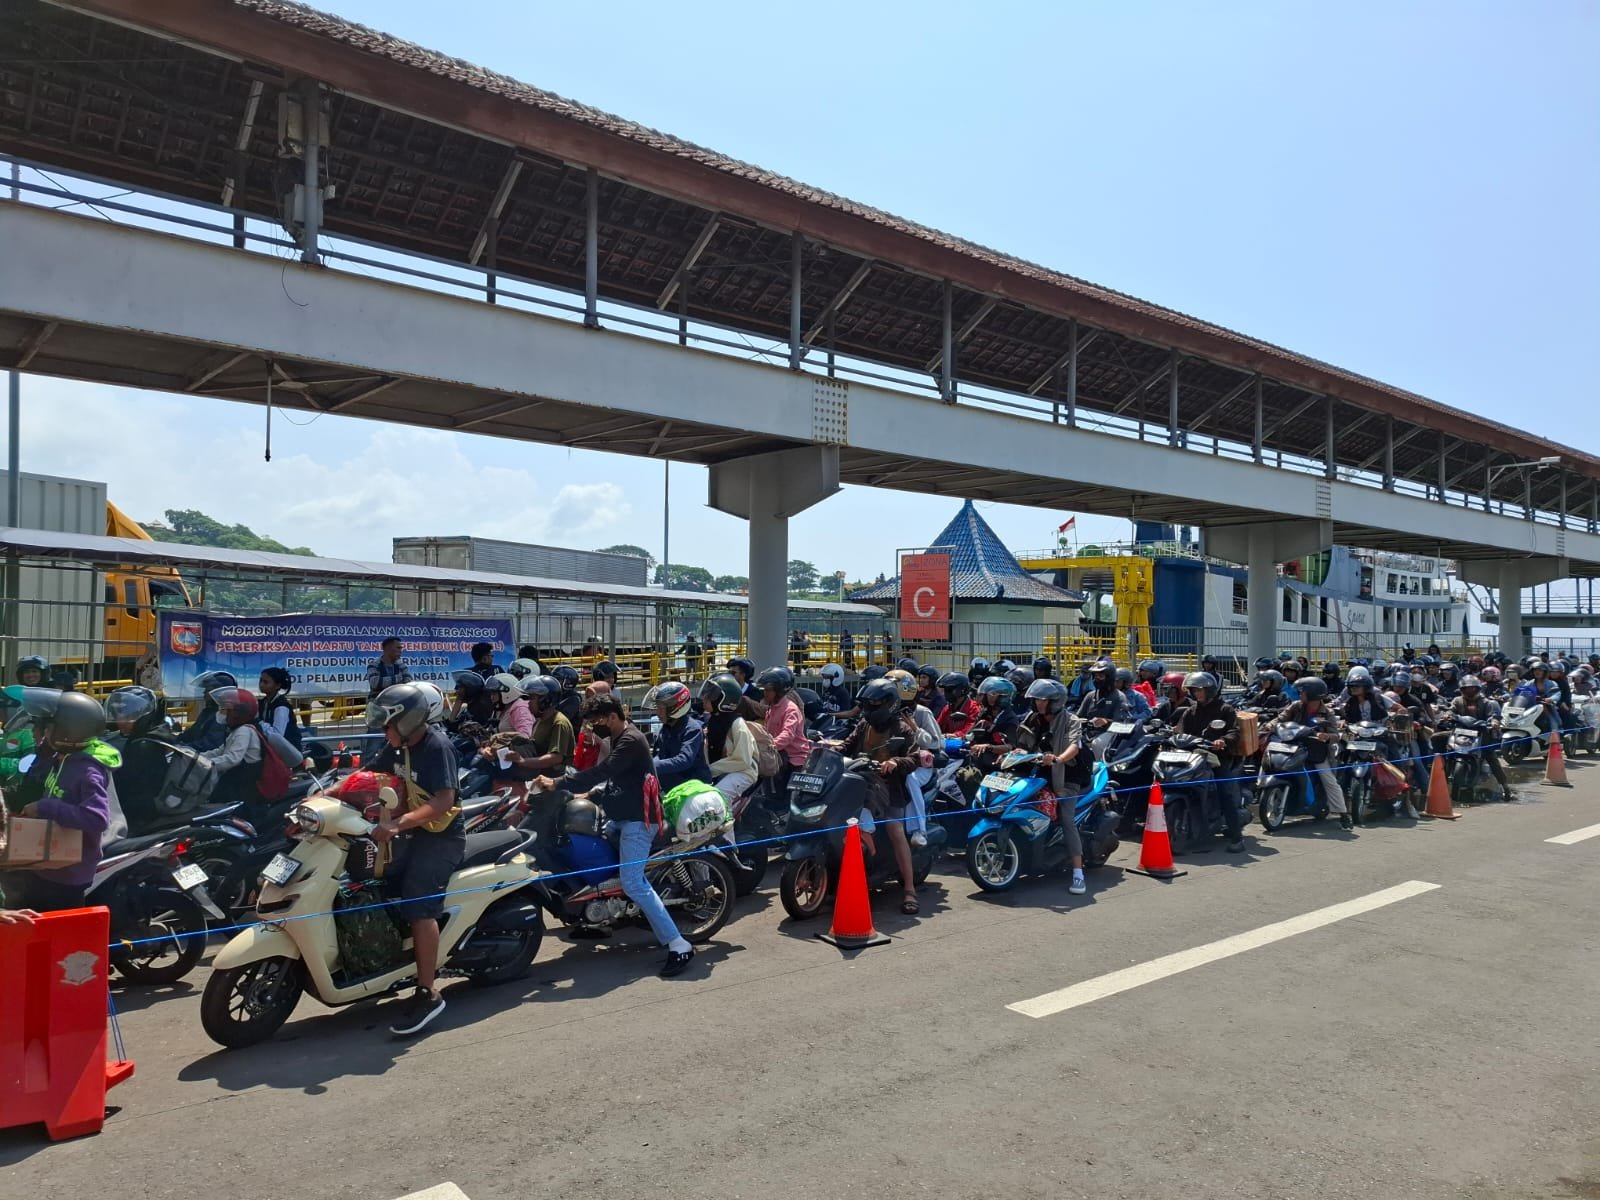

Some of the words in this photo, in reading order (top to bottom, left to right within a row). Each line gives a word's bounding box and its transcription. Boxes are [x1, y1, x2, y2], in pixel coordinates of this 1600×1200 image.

[913, 586, 936, 617] C
[222, 625, 274, 636] MOHON
[277, 625, 313, 636] MAAF
[315, 625, 395, 637] PERJALANAN
[398, 626, 430, 637] ANDA
[431, 627, 497, 637] TERGANGGU
[216, 641, 310, 652] PEMERIKSAAN
[312, 641, 355, 652] KARTU
[402, 642, 457, 652] PENDUDUK
[287, 657, 356, 668] PENDUDUK
[289, 674, 303, 684] DI
